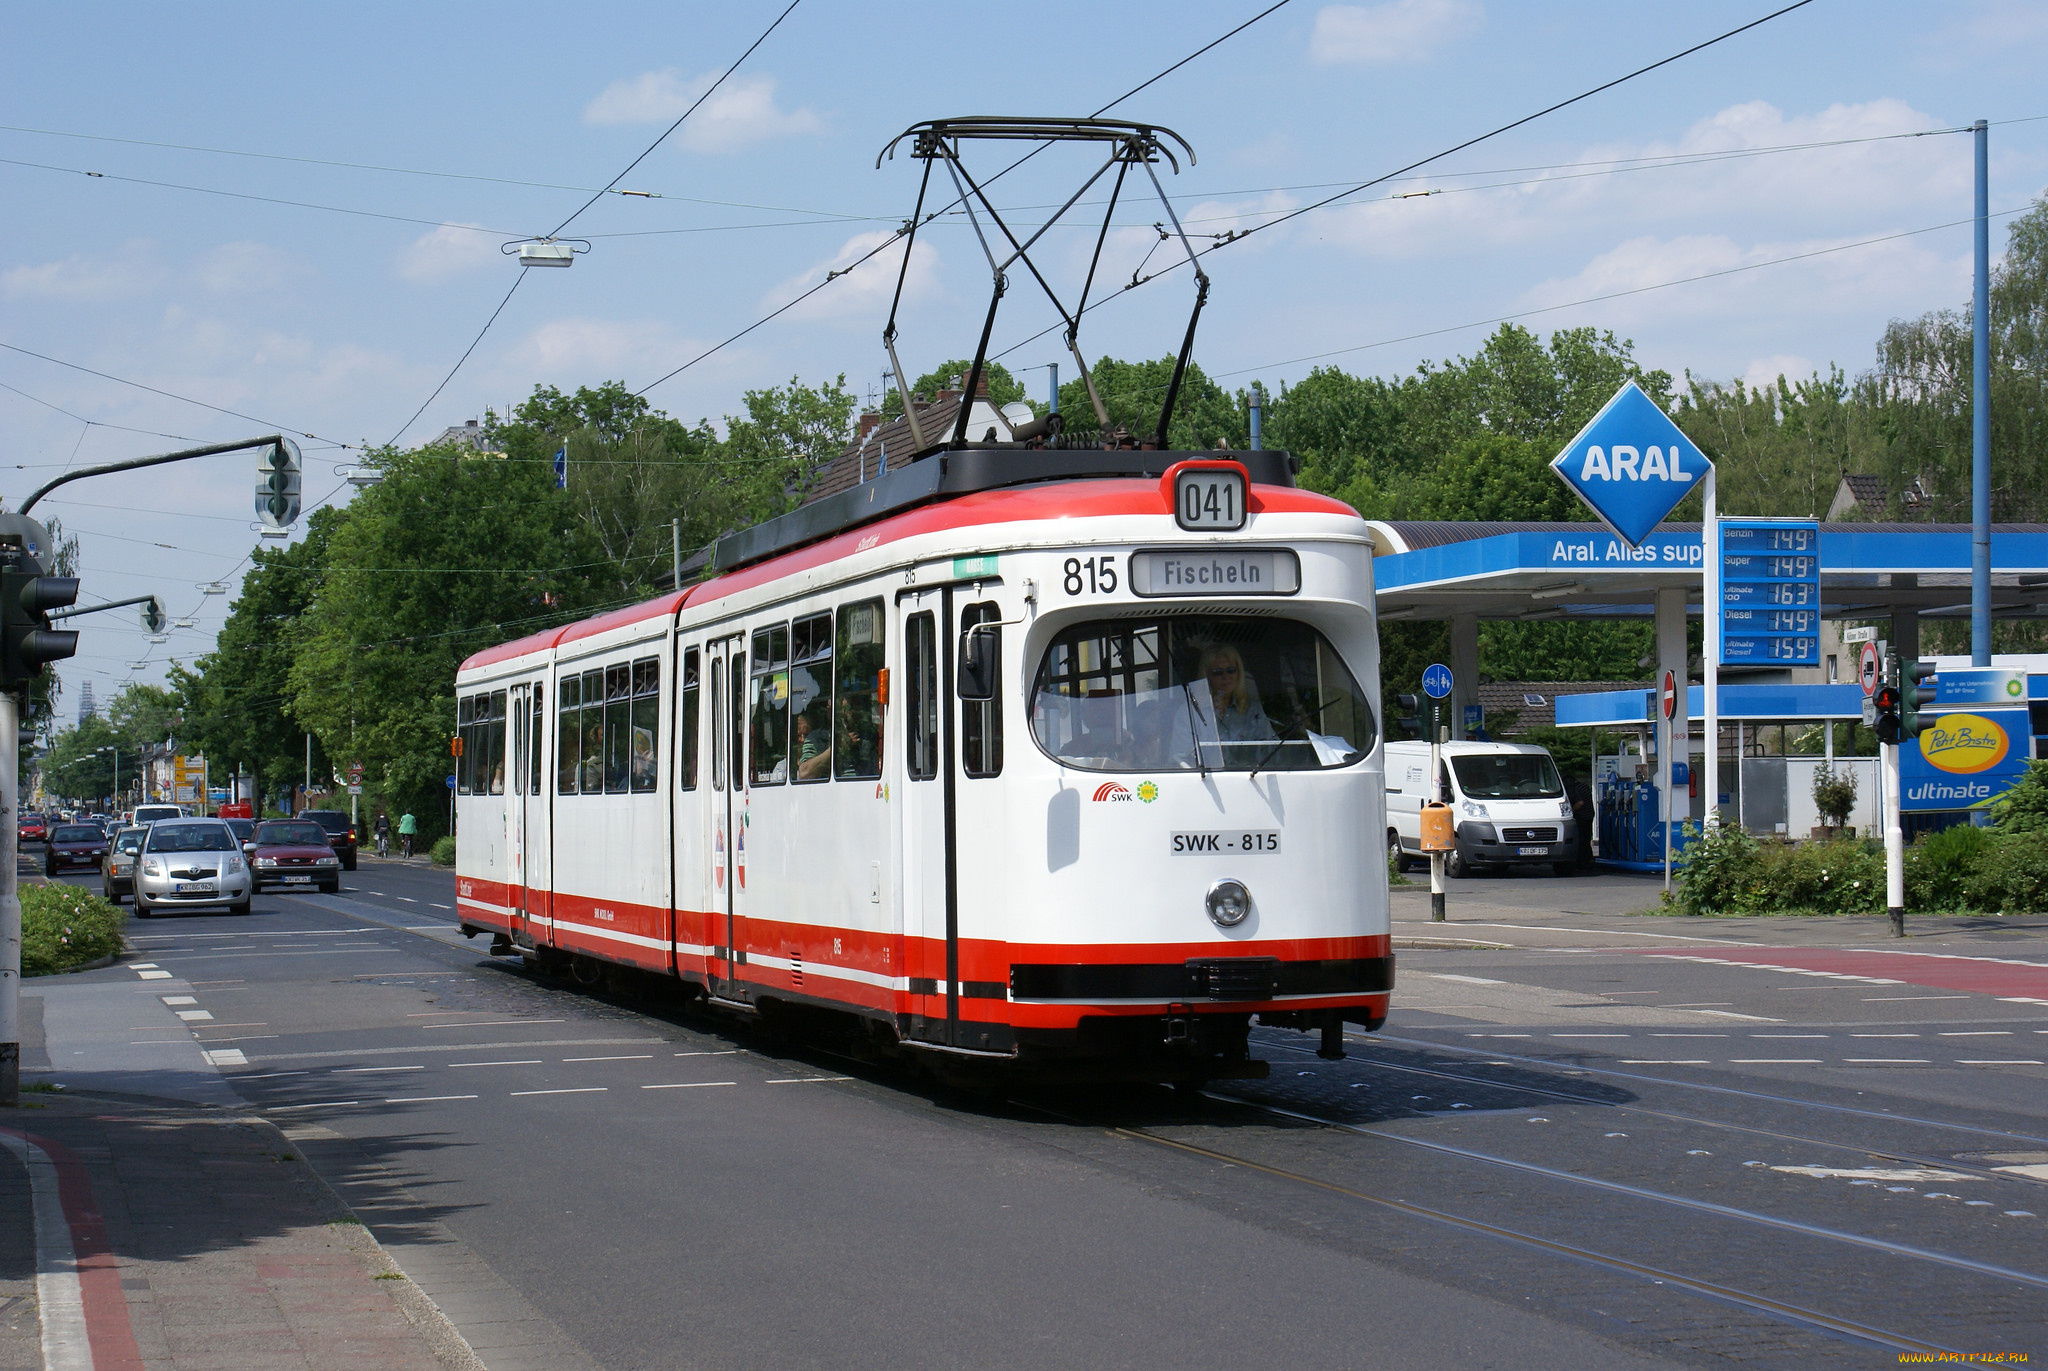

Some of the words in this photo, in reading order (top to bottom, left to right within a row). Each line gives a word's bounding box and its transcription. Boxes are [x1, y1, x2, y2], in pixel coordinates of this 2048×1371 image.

[1581, 446, 1692, 481] ARAL
[1185, 483, 1233, 521] 041
[1724, 529, 1753, 538] Benzin
[1552, 540, 1600, 561] Aral.
[1605, 541, 1657, 561] Alles
[1662, 545, 1702, 565] sup
[1724, 556, 1751, 566] Super
[905, 567, 916, 584] 815
[1063, 556, 1118, 596] 815
[1165, 560, 1260, 585] Fischeln
[1725, 610, 1752, 619] Diesel
[1929, 729, 1957, 751] Petit
[1955, 728, 1996, 748] Bistro
[1111, 793, 1133, 802] SWK
[1908, 781, 1990, 800] ultimate
[1173, 834, 1220, 852] SWK
[1241, 833, 1278, 851] 815
